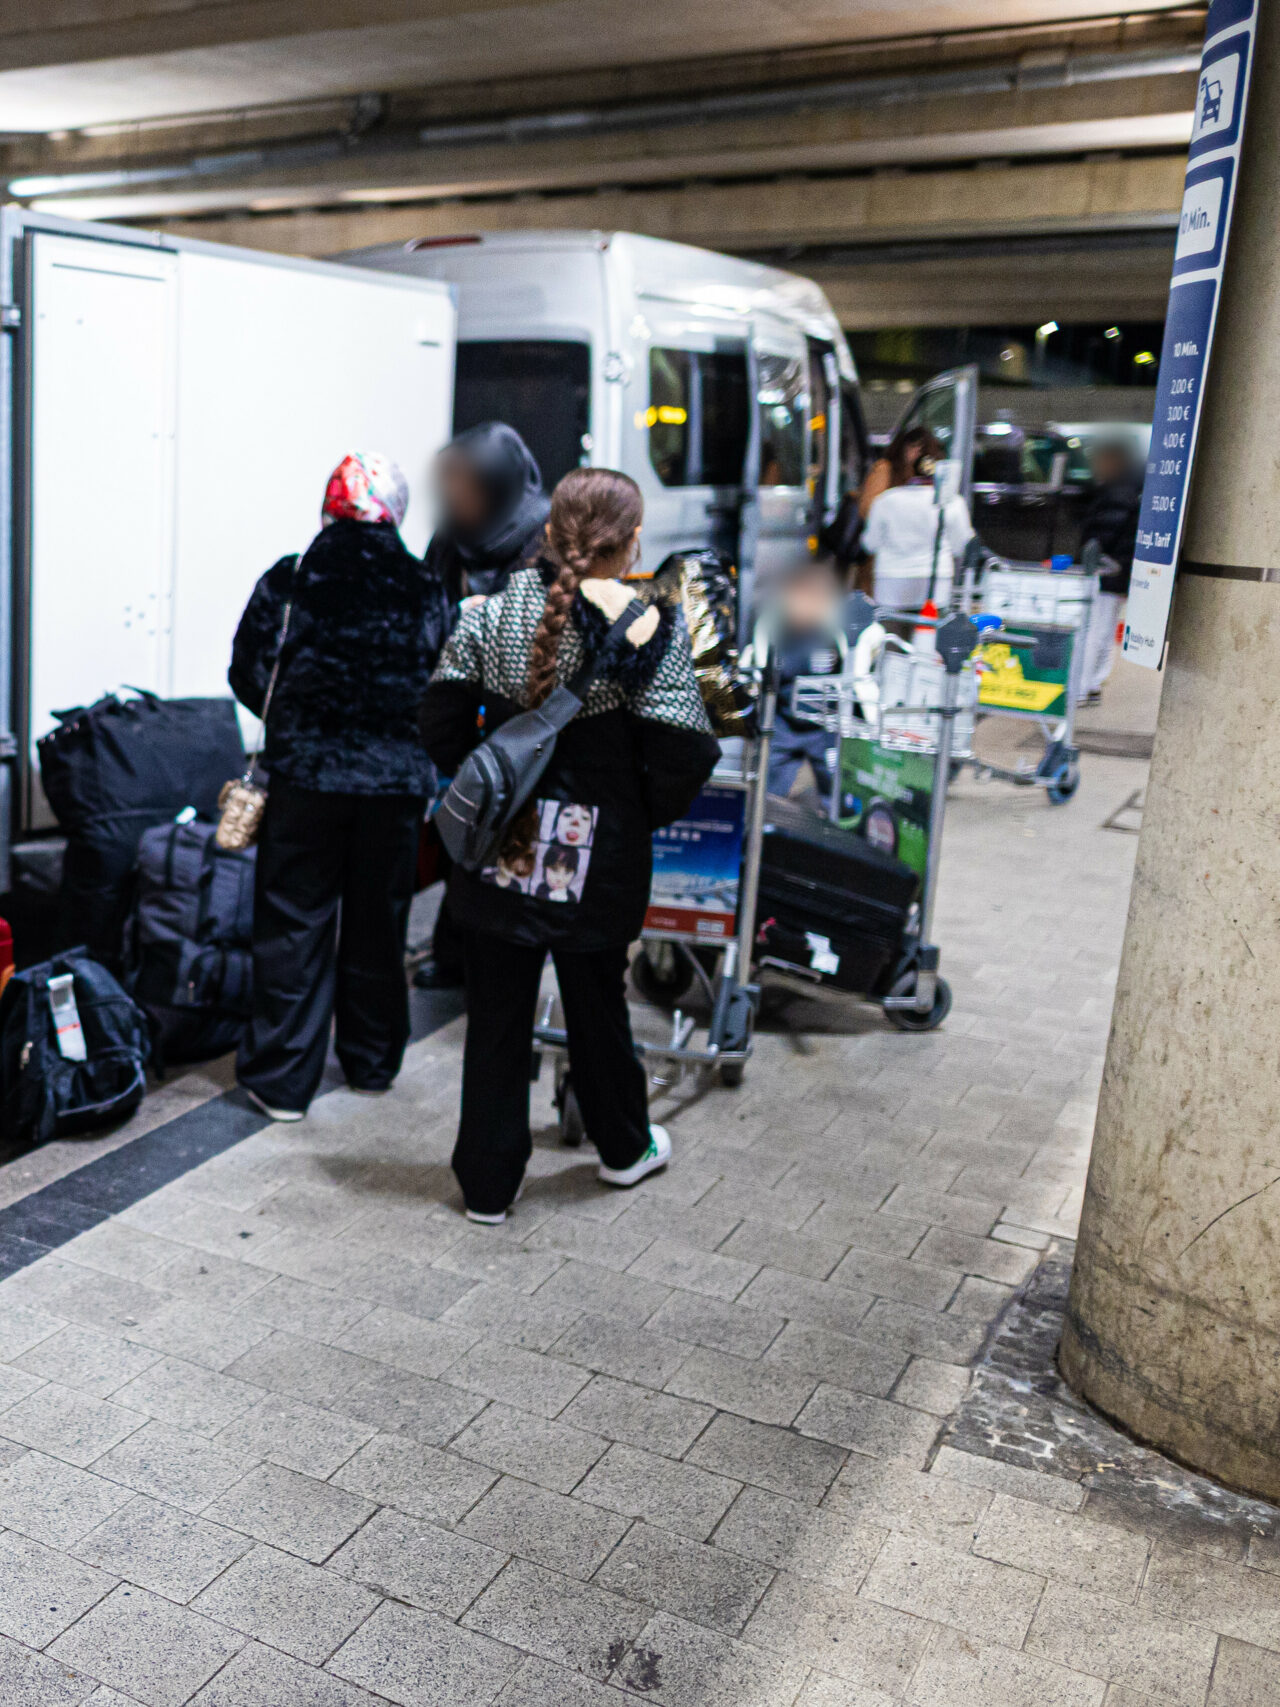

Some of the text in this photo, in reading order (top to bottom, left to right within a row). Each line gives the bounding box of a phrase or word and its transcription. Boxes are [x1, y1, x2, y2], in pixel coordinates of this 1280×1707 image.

[1188, 206, 1211, 232] Min.
[1182, 340, 1199, 356] Min.
[1154, 532, 1172, 548] Tarif
